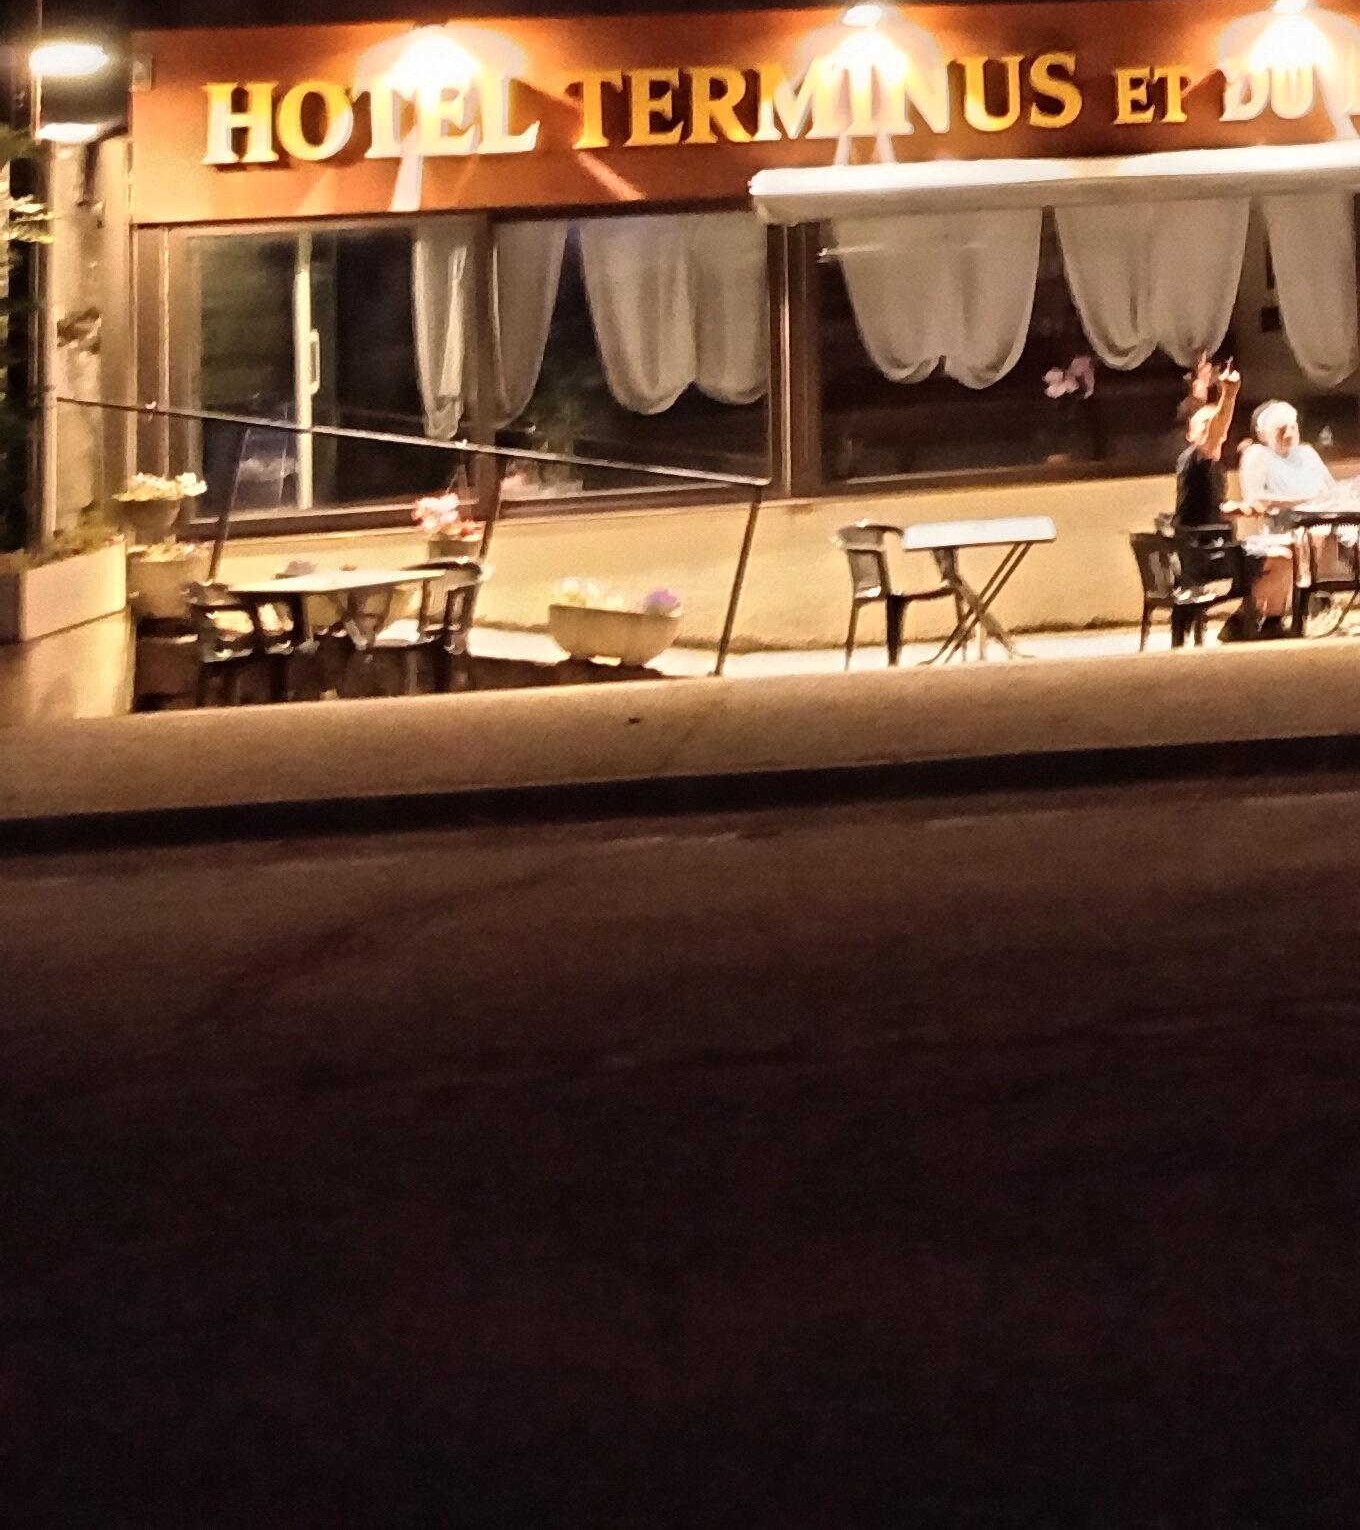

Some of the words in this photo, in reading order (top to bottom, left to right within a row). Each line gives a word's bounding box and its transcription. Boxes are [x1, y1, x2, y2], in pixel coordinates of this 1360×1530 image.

[201, 71, 540, 165] HOTEL
[564, 50, 1083, 150] TERMINUS
[1112, 65, 1192, 125] ET
[1218, 60, 1321, 122] DU
